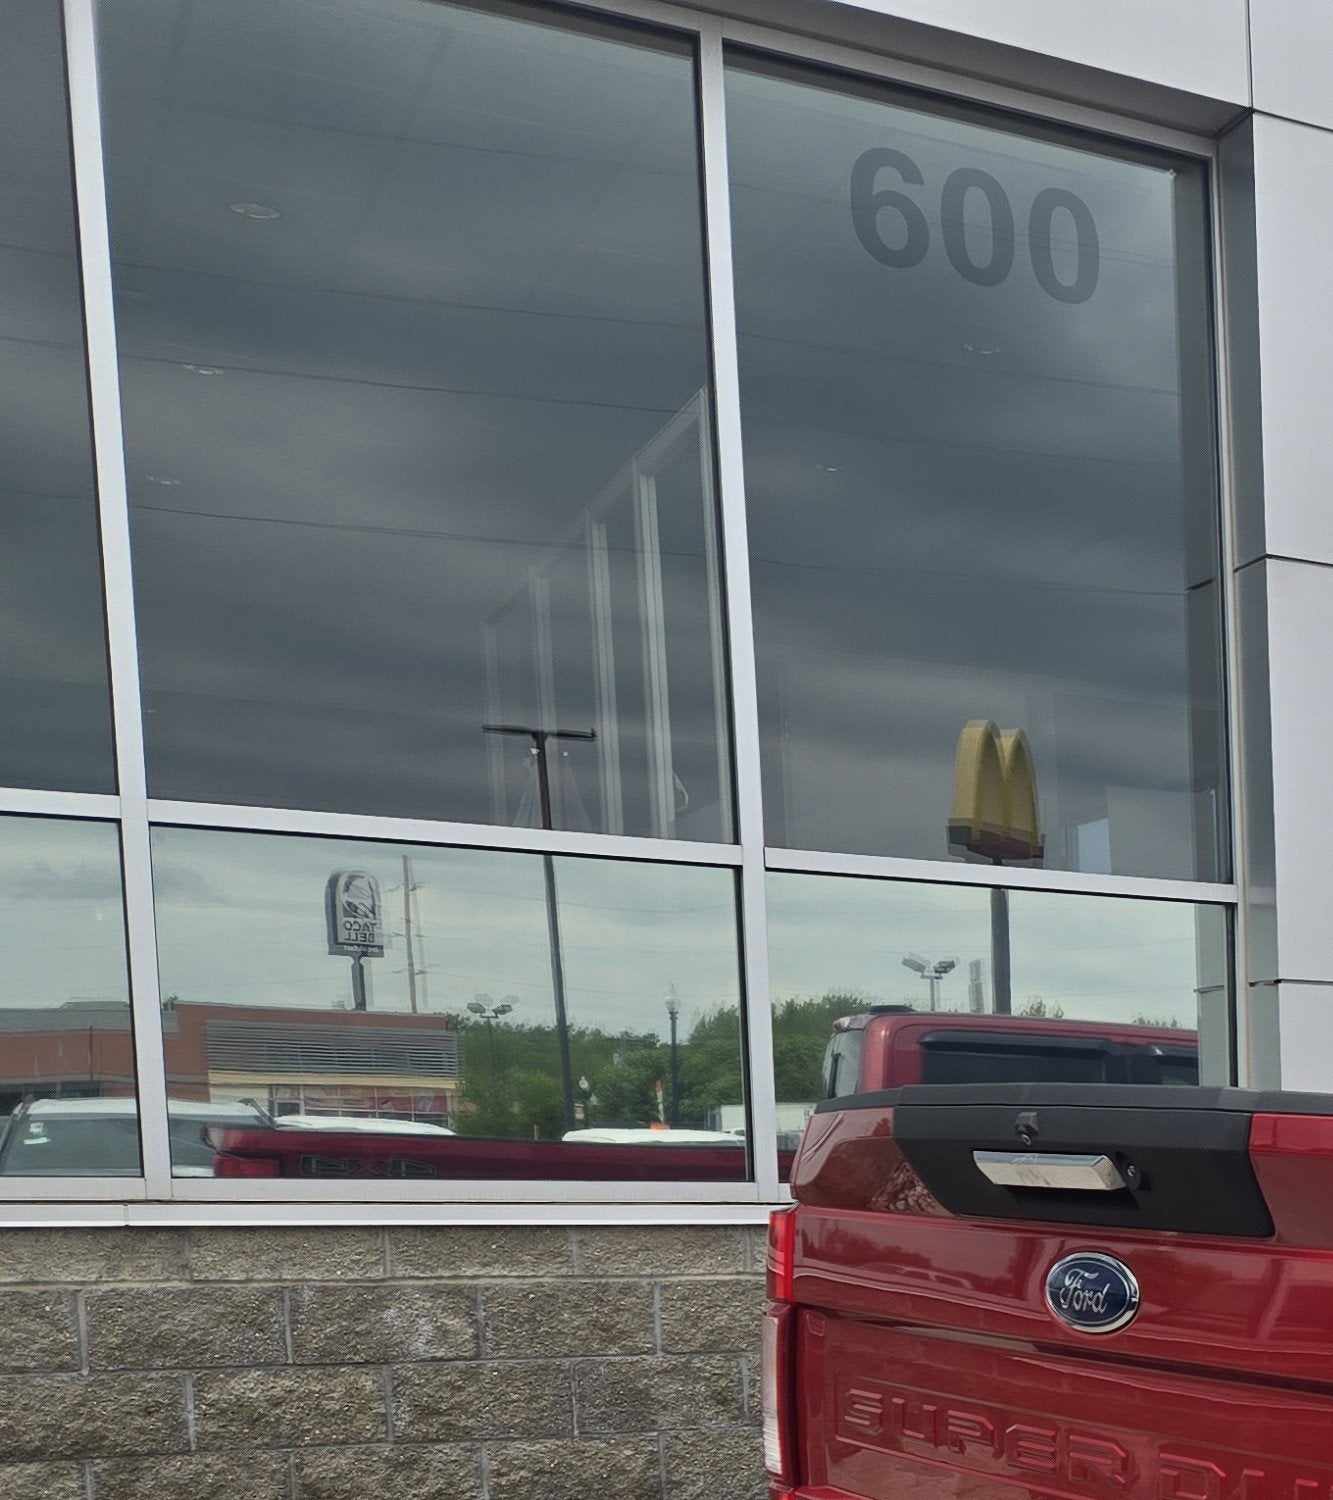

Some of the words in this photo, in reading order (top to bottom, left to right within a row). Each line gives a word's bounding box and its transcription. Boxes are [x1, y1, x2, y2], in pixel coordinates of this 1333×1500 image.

[850, 147, 1100, 305] 600
[1060, 1268, 1111, 1314] Ford
[842, 1388, 1129, 1492] SUPER
